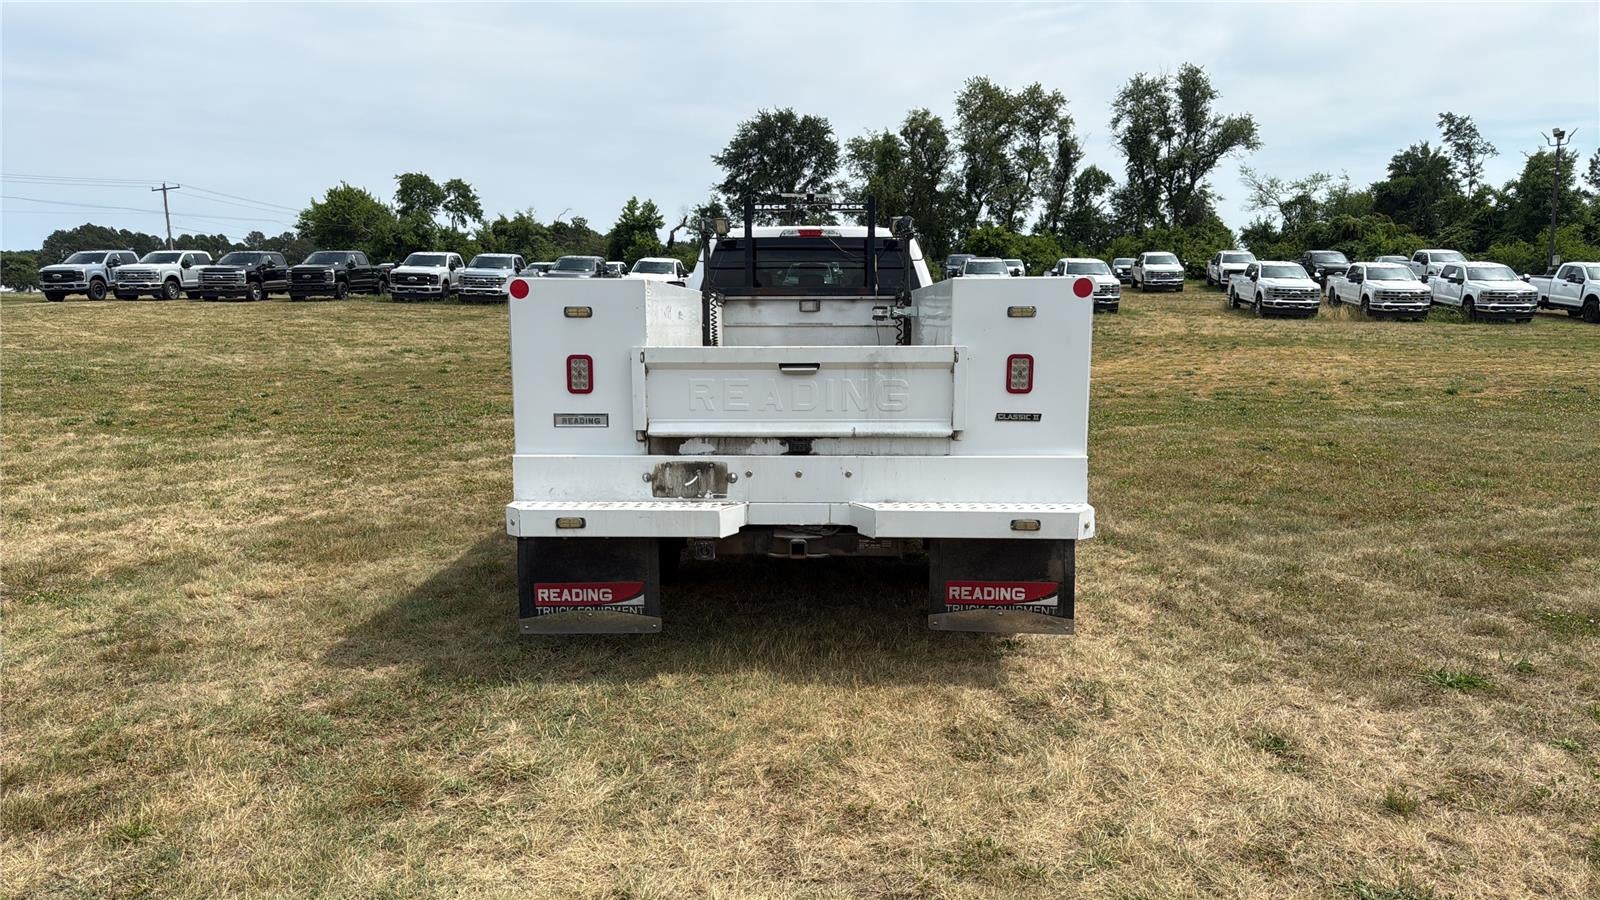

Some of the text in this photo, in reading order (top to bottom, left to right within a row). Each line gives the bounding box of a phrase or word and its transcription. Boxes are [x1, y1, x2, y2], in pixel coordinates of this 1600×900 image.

[688, 377, 910, 413] READING
[561, 417, 601, 425] READING
[537, 588, 613, 602] READING
[948, 586, 1026, 601] READING
